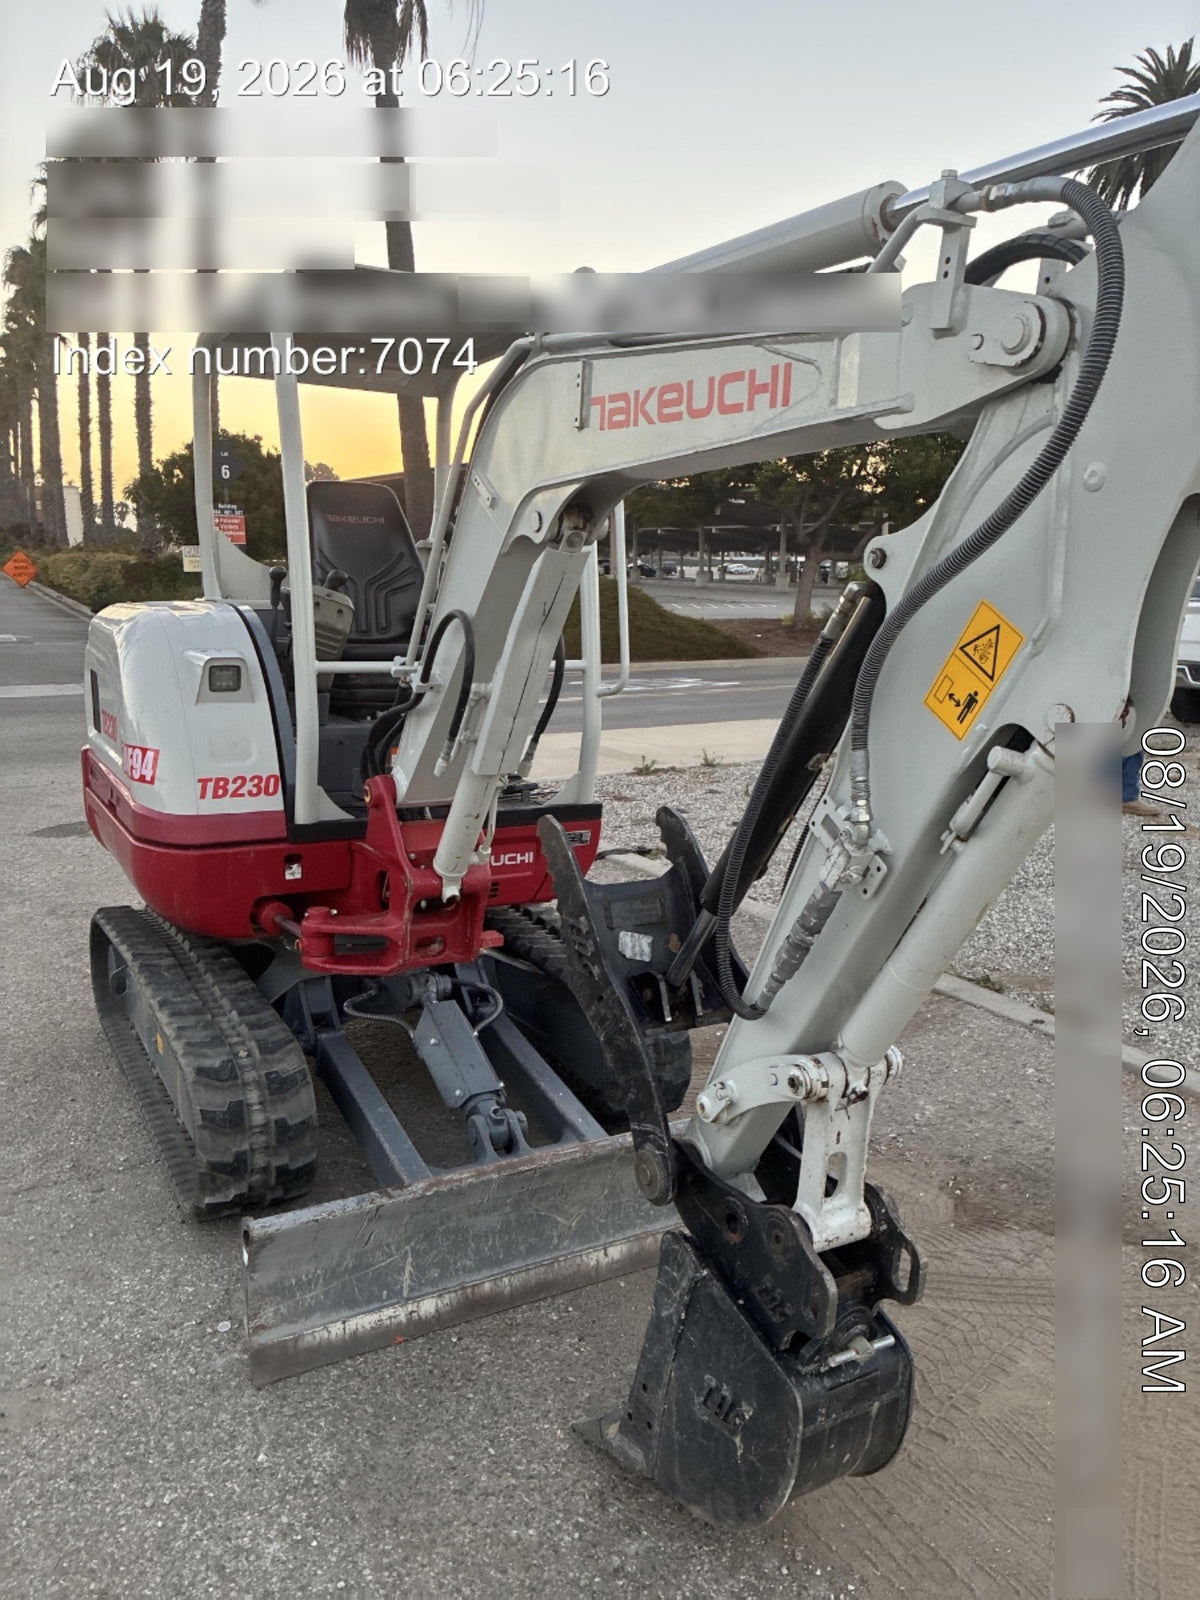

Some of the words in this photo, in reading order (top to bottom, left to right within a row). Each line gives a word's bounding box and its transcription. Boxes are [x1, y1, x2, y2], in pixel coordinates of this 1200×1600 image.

[221, 464, 230, 479] 6
[197, 774, 280, 800] TB230
[490, 852, 534, 867] UCHI
